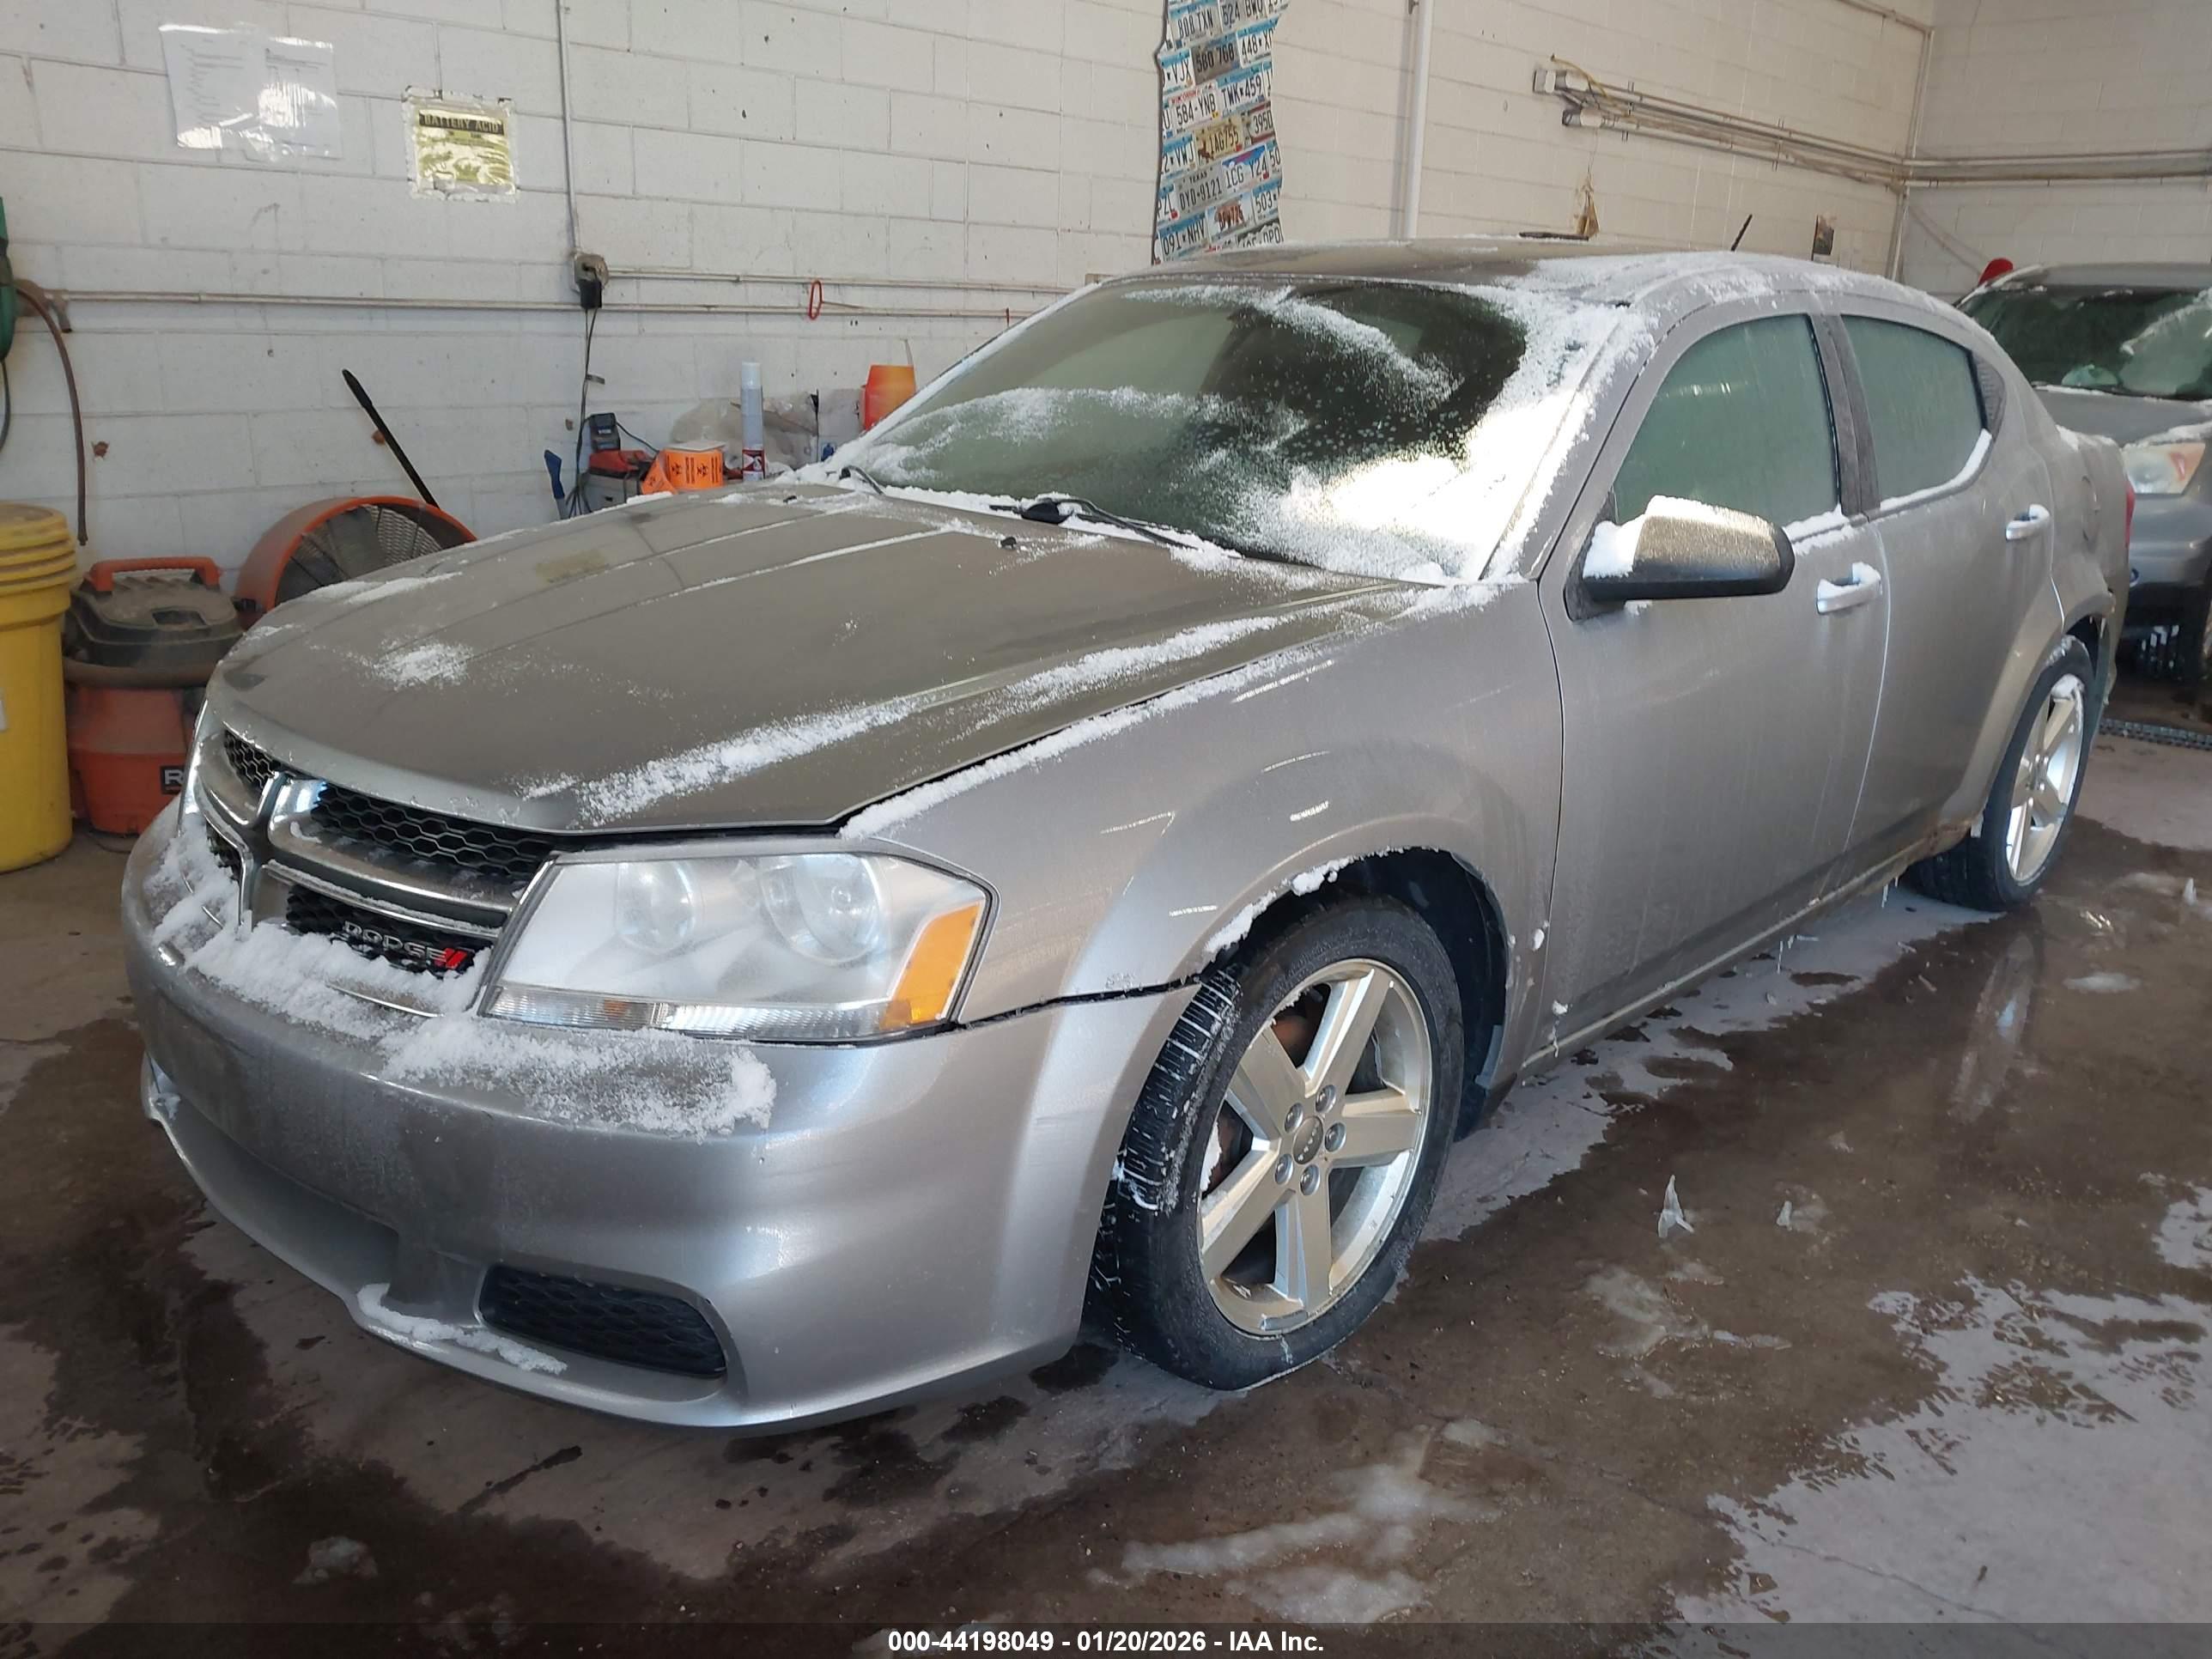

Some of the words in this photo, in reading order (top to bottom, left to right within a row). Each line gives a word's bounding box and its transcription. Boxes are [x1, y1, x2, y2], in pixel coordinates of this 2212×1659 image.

[424, 113, 470, 130] BATTERY
[475, 120, 499, 132] ACID
[344, 921, 447, 963] DODGE
